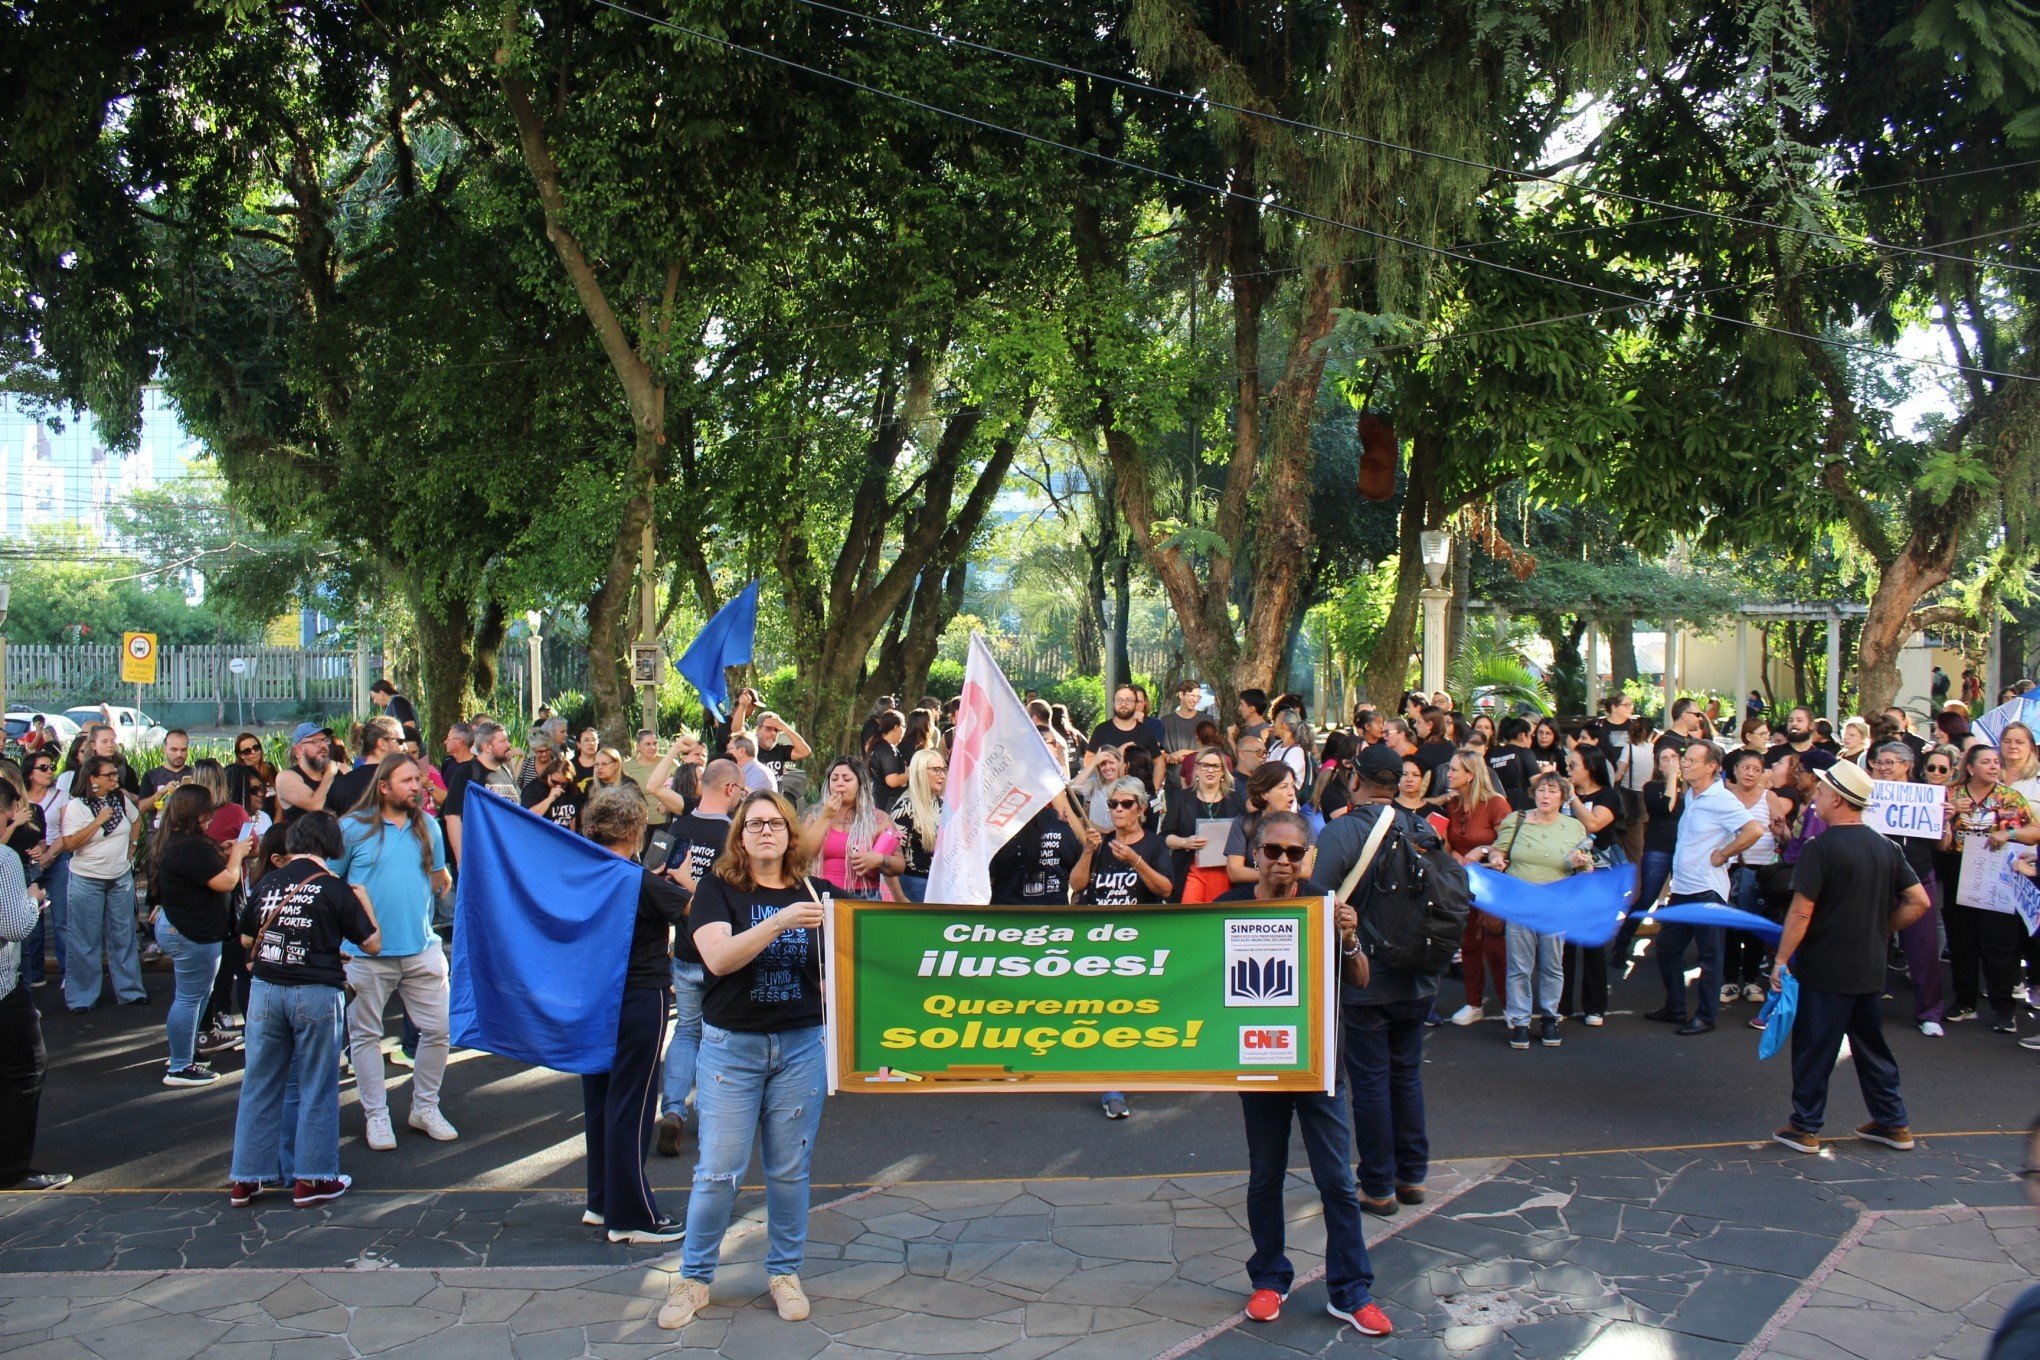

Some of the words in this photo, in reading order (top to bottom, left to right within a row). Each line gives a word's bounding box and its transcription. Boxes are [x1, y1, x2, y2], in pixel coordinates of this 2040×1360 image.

[692, 856, 711, 867] OMOS
[691, 867, 704, 875] AIS
[1095, 872, 1138, 889] LUTO
[751, 904, 784, 920] LIVRO
[278, 916, 313, 928] FORTES
[1230, 924, 1293, 934] SINPROCAN
[943, 924, 1075, 946] Chega
[1087, 924, 1139, 942] de
[917, 949, 1171, 977] ilusões!
[923, 994, 1160, 1018] Queremos
[880, 1019, 1204, 1056] soluções!
[1244, 1030, 1290, 1049] CNTE
